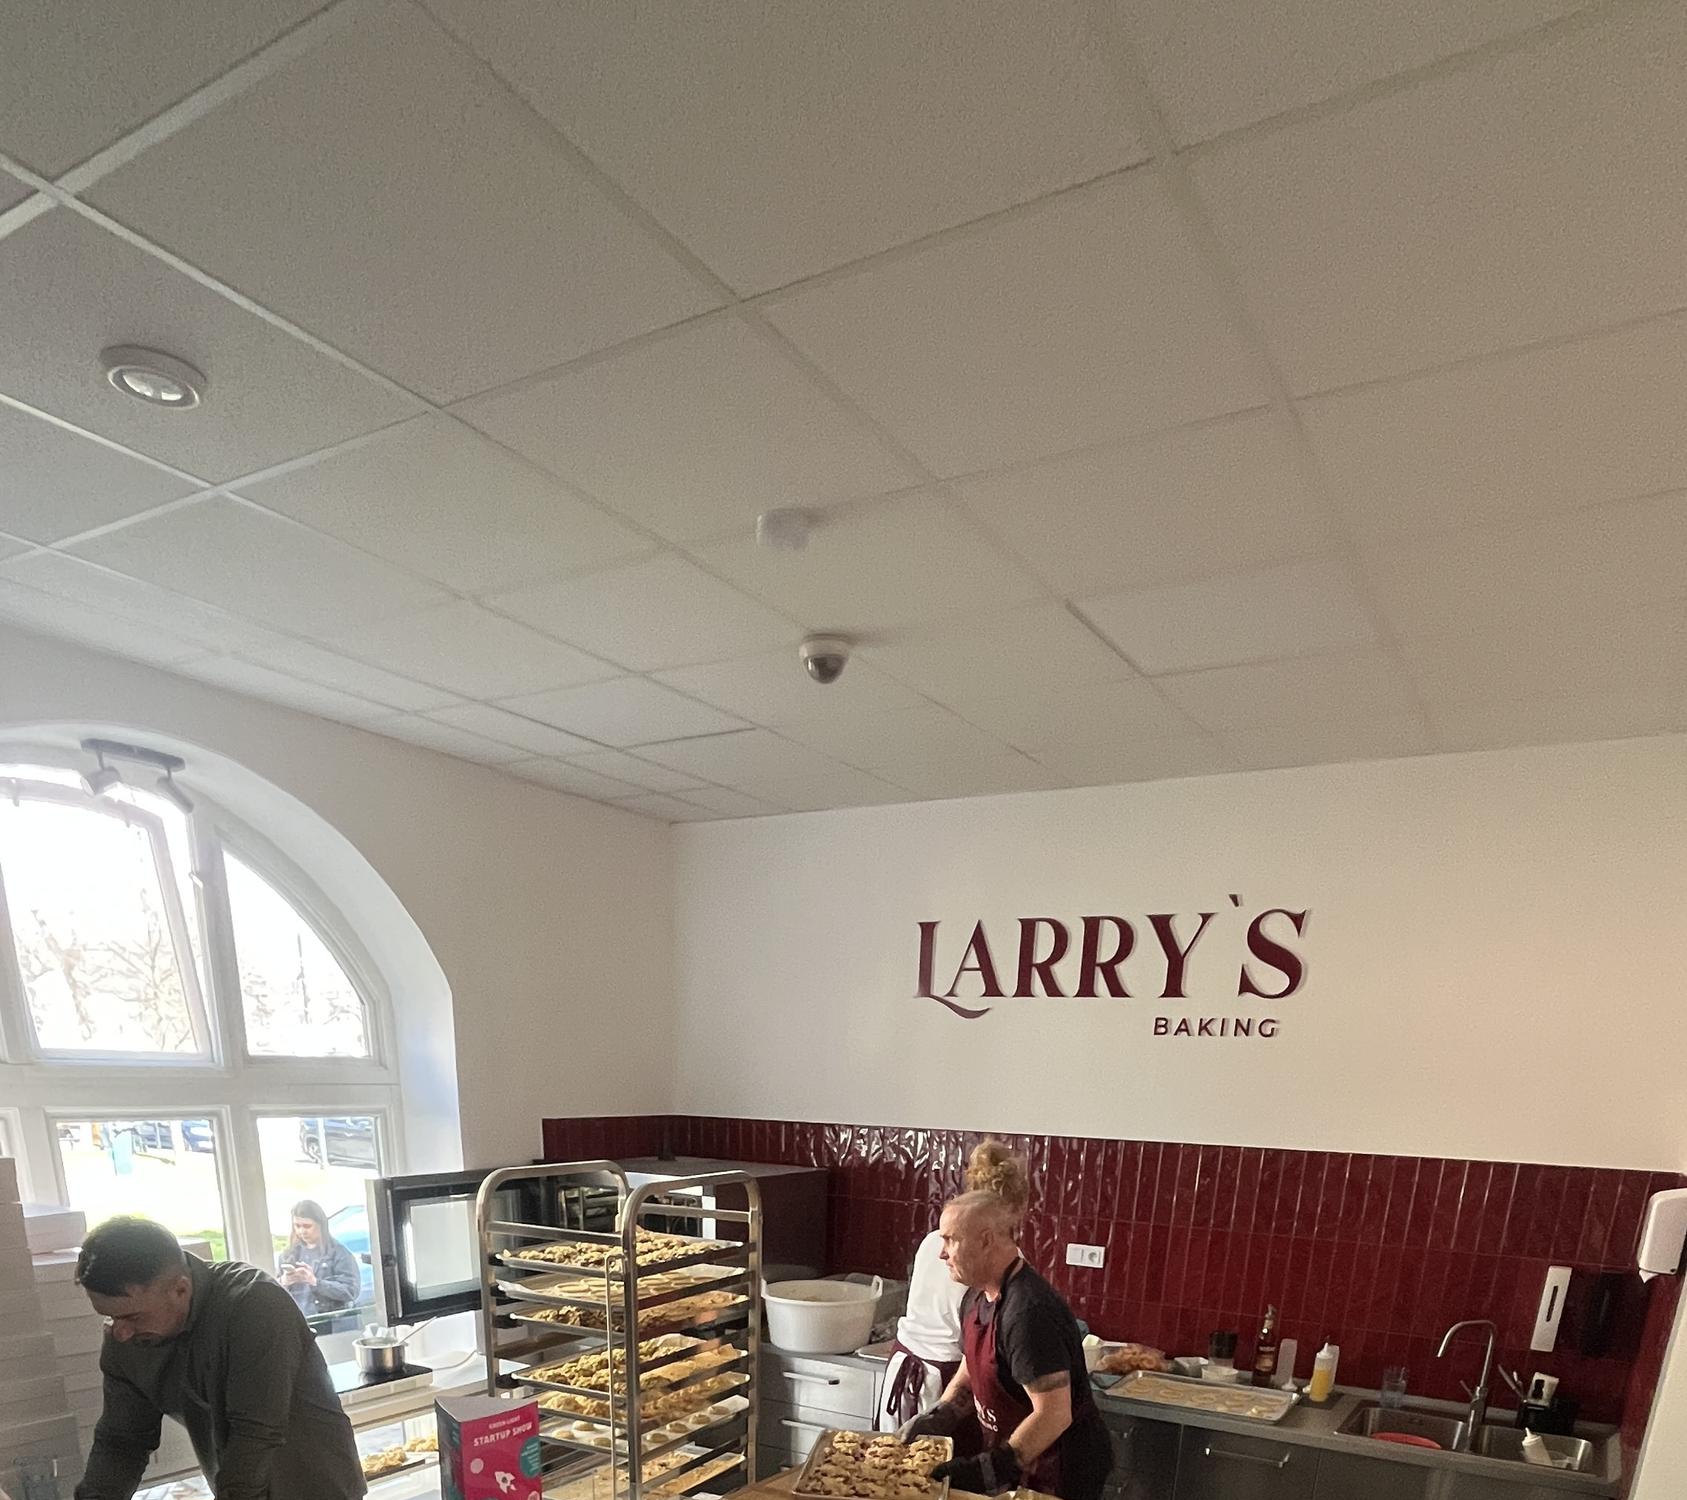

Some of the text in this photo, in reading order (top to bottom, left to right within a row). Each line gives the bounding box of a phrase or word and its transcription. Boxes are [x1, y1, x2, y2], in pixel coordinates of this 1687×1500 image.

[1153, 1017, 1279, 1038] BAKING
[473, 1422, 533, 1447] STARTUP SHOW
